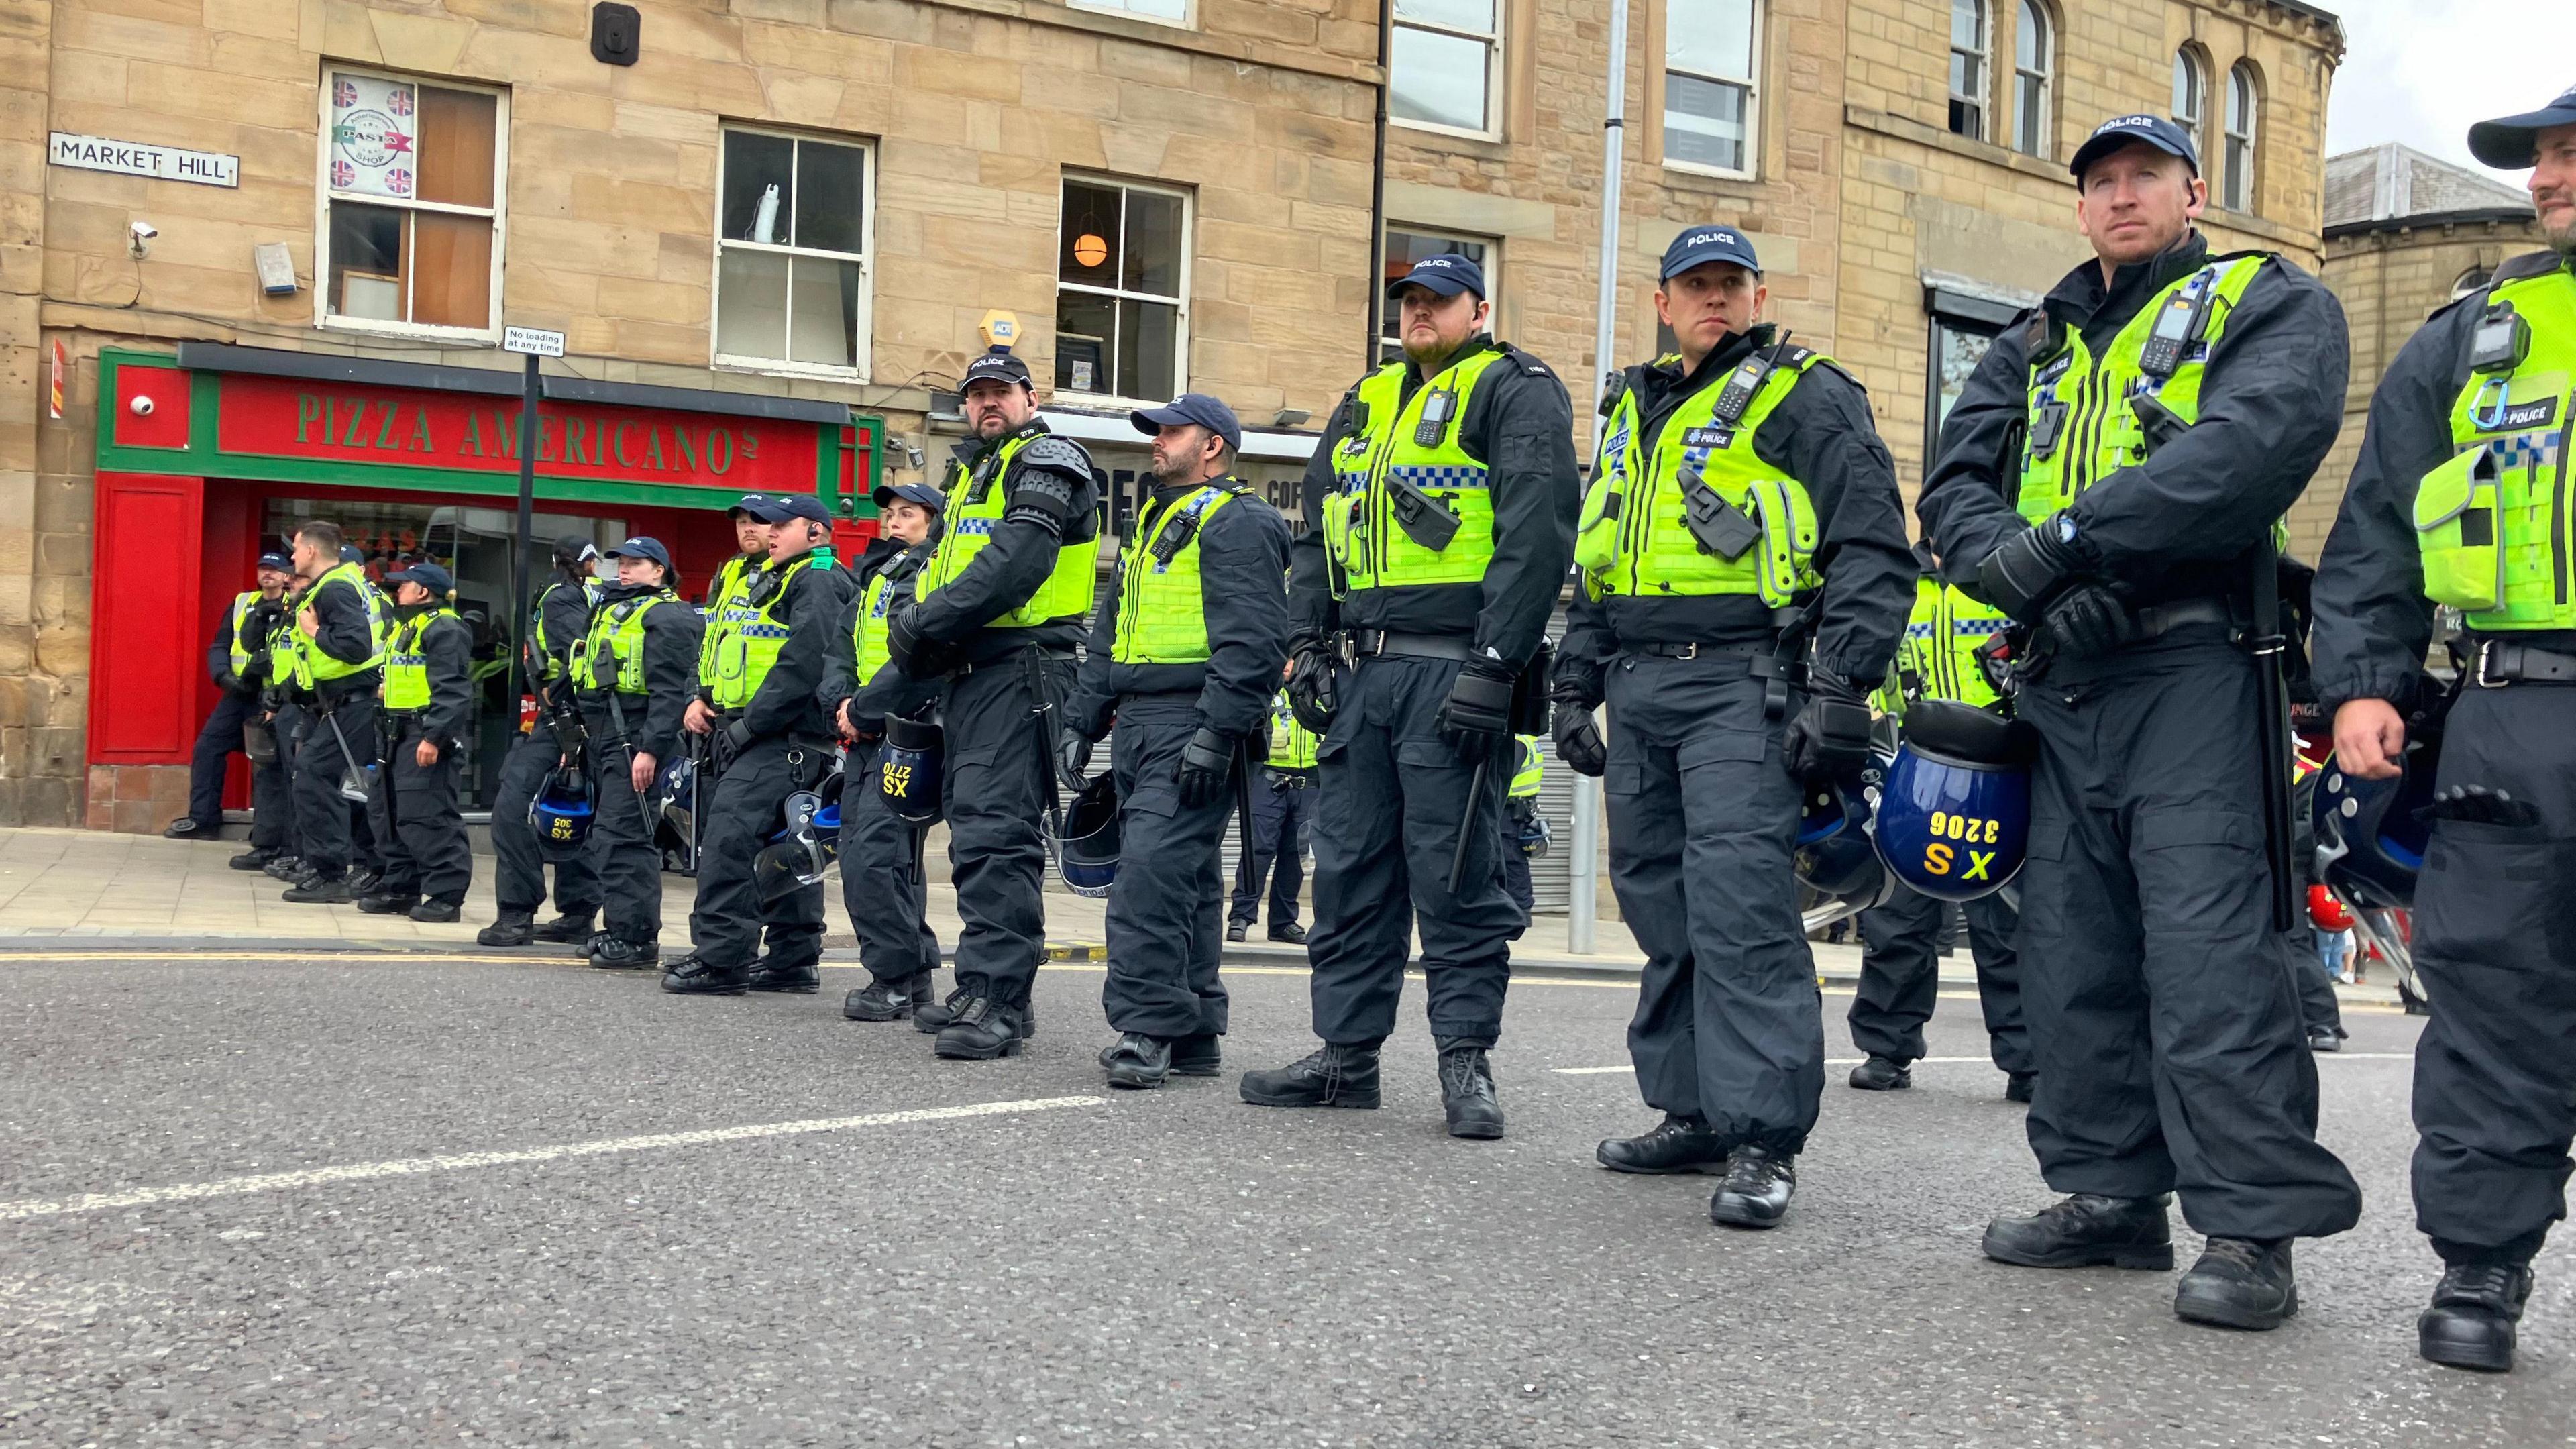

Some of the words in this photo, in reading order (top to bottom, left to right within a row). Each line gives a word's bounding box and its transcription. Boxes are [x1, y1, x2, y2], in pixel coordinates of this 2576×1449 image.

[2097, 117, 2153, 135] POLICE
[343, 129, 397, 144] PASTA
[61, 140, 162, 170] MARKET
[178, 156, 225, 178] HILL
[356, 152, 384, 164] SHOP
[1688, 233, 1735, 248] POLICE
[1414, 259, 1452, 270] POLICE
[995, 324, 1012, 333] ADT
[510, 330, 523, 338] No
[526, 332, 559, 344] loading
[521, 342, 537, 350] any
[540, 343, 560, 352] time
[971, 358, 1005, 370] POLICE
[294, 392, 436, 453] PIZZA
[2508, 406, 2547, 425] POLICE
[1020, 428, 1034, 437] 2770
[1700, 433, 1727, 444] POLICE
[883, 761, 912, 780] 2770
[883, 775, 909, 798] XS
[554, 818, 572, 828] 305
[1929, 810, 2000, 845] 3206
[551, 828, 574, 839] XS
